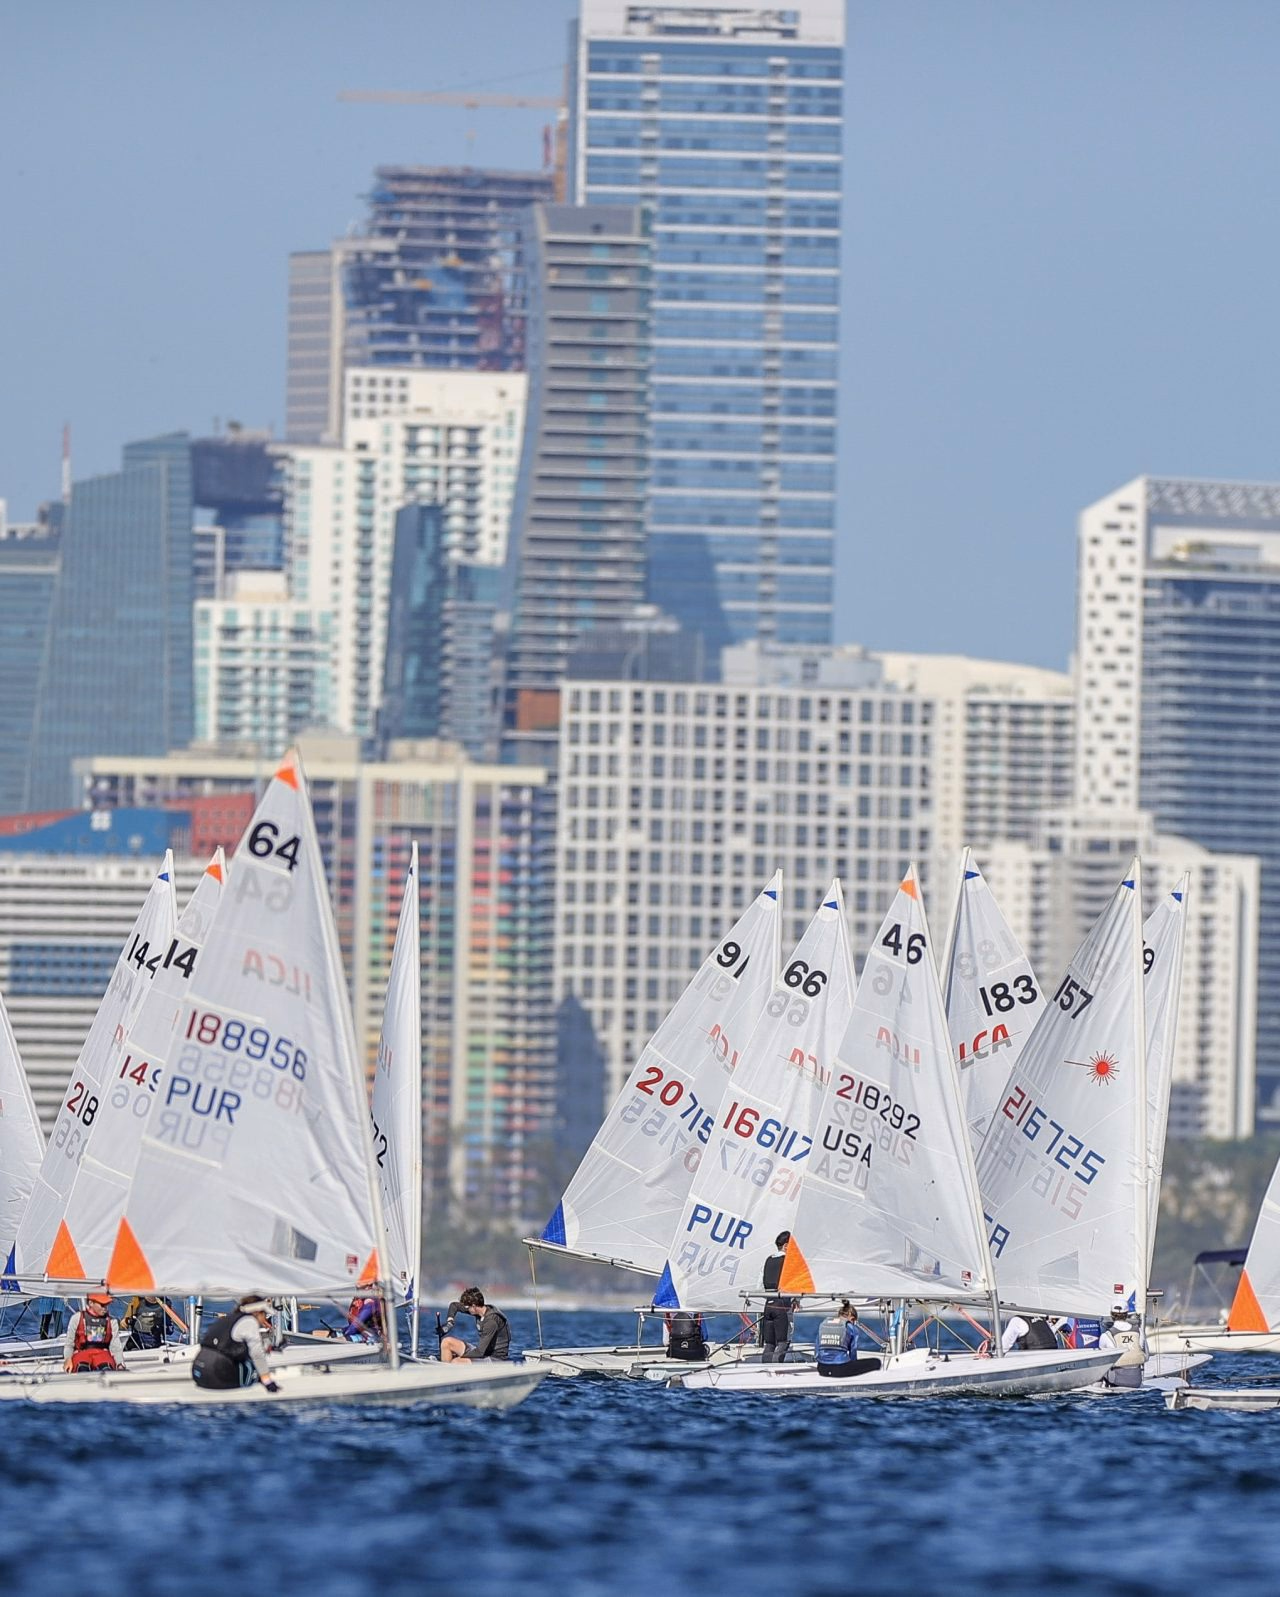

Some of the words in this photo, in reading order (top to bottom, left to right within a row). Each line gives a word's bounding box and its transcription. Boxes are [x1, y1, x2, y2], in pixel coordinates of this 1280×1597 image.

[248, 821, 301, 871] 64
[716, 941, 750, 979] 91
[881, 923, 927, 965] 46
[783, 960, 827, 997] 66
[979, 975, 1038, 1017] 183
[1053, 974, 1094, 1020] 157
[185, 1009, 307, 1081] 188956
[166, 1076, 241, 1125] PUR
[836, 1074, 920, 1140] 218292
[723, 1101, 812, 1162] 166117
[823, 1125, 872, 1168] USA
[1002, 1085, 1106, 1185] 216725
[686, 1204, 753, 1249] PUR
[1122, 1336, 1134, 1344] ZK
